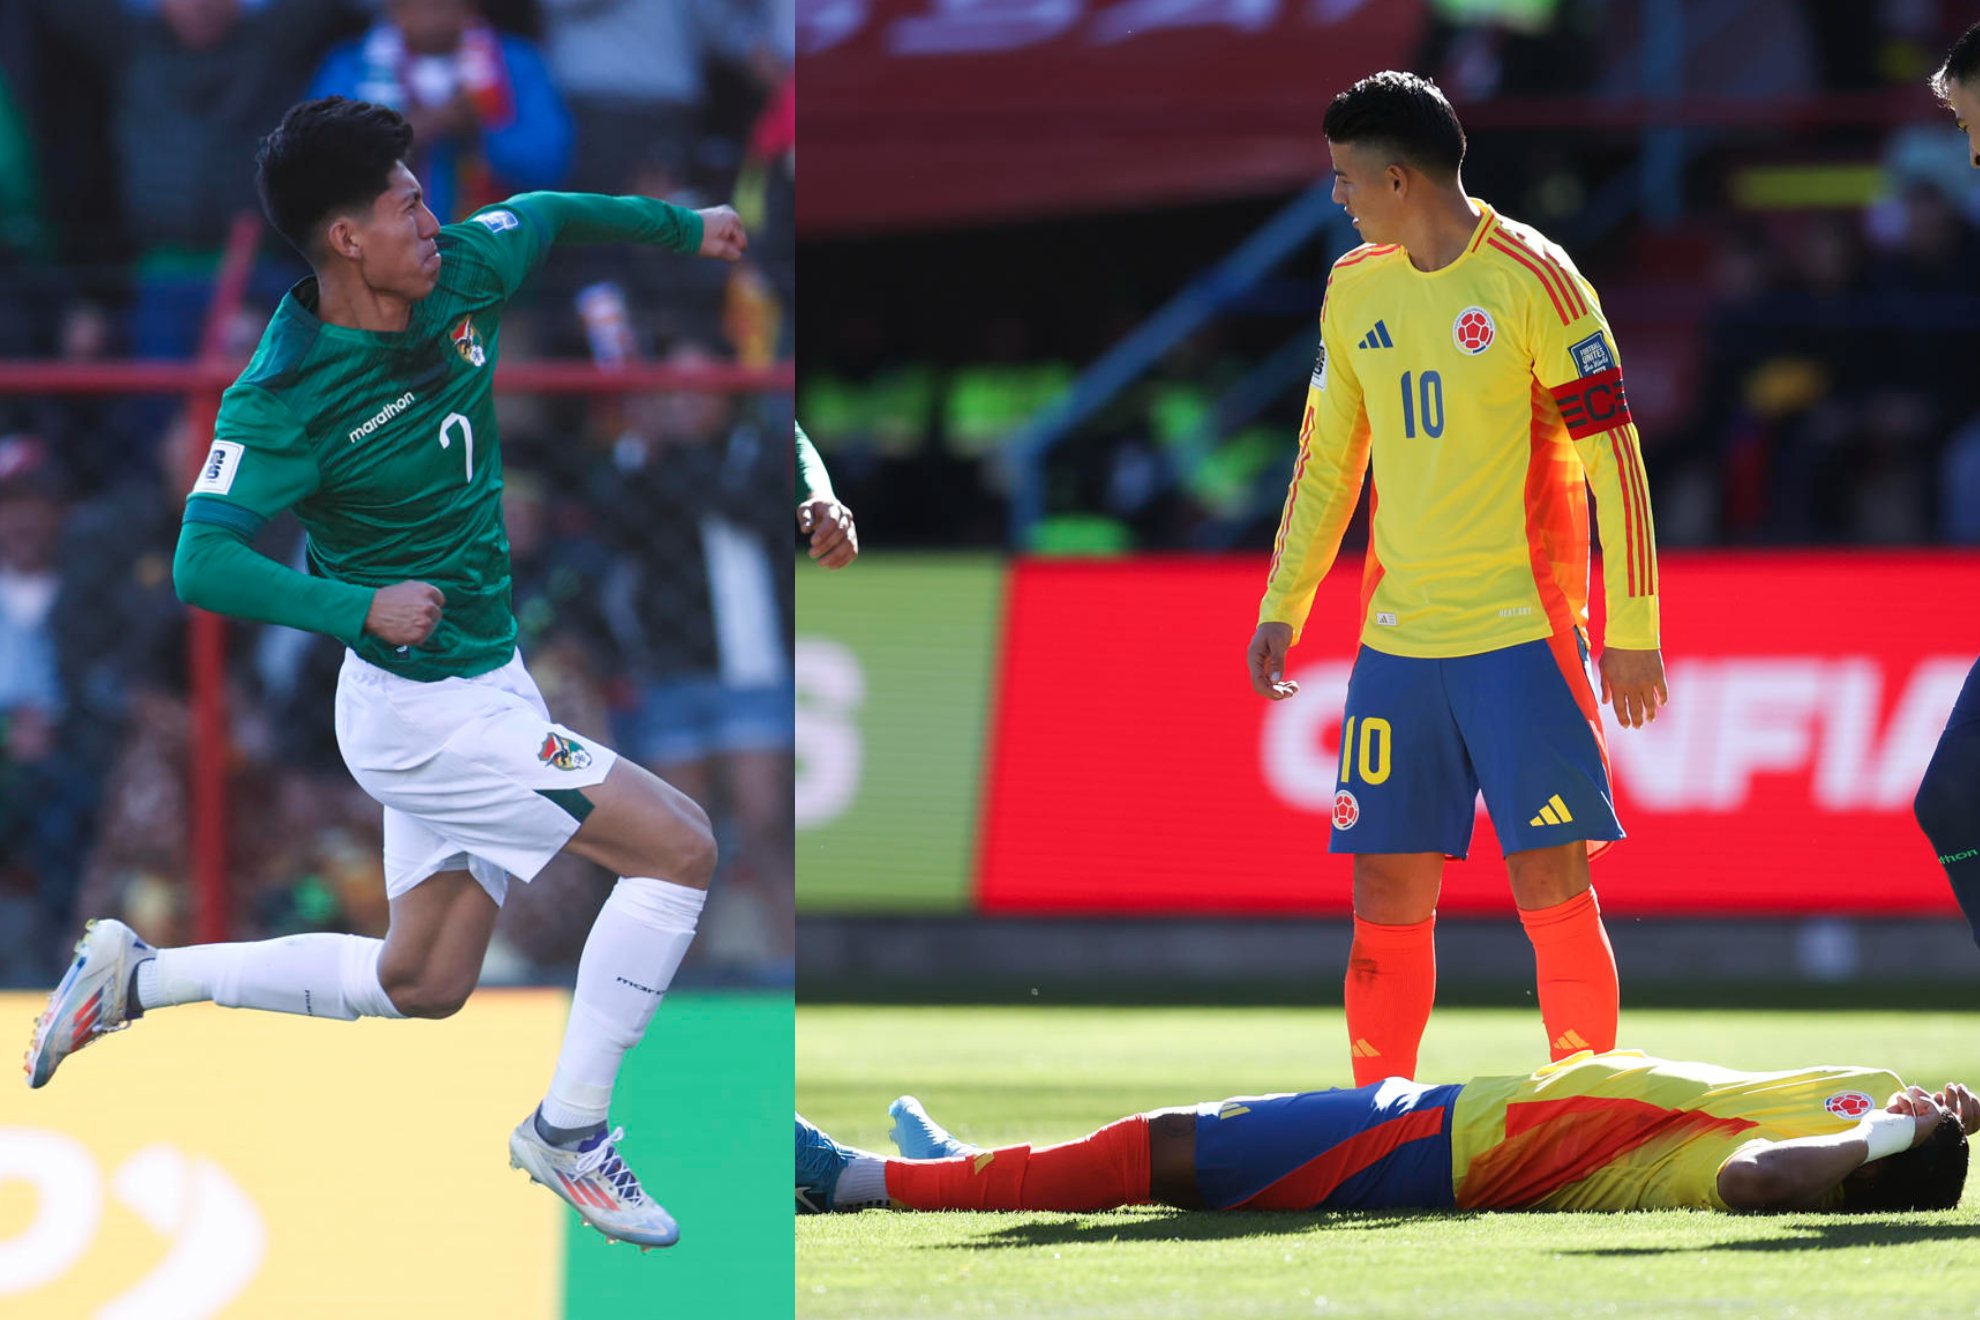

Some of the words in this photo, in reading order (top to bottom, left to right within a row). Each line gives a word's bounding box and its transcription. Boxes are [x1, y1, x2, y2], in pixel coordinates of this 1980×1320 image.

[349, 391, 415, 443] marathon
[1401, 370, 1444, 438] 10
[439, 412, 474, 484] 7
[1341, 716, 1391, 785] 10
